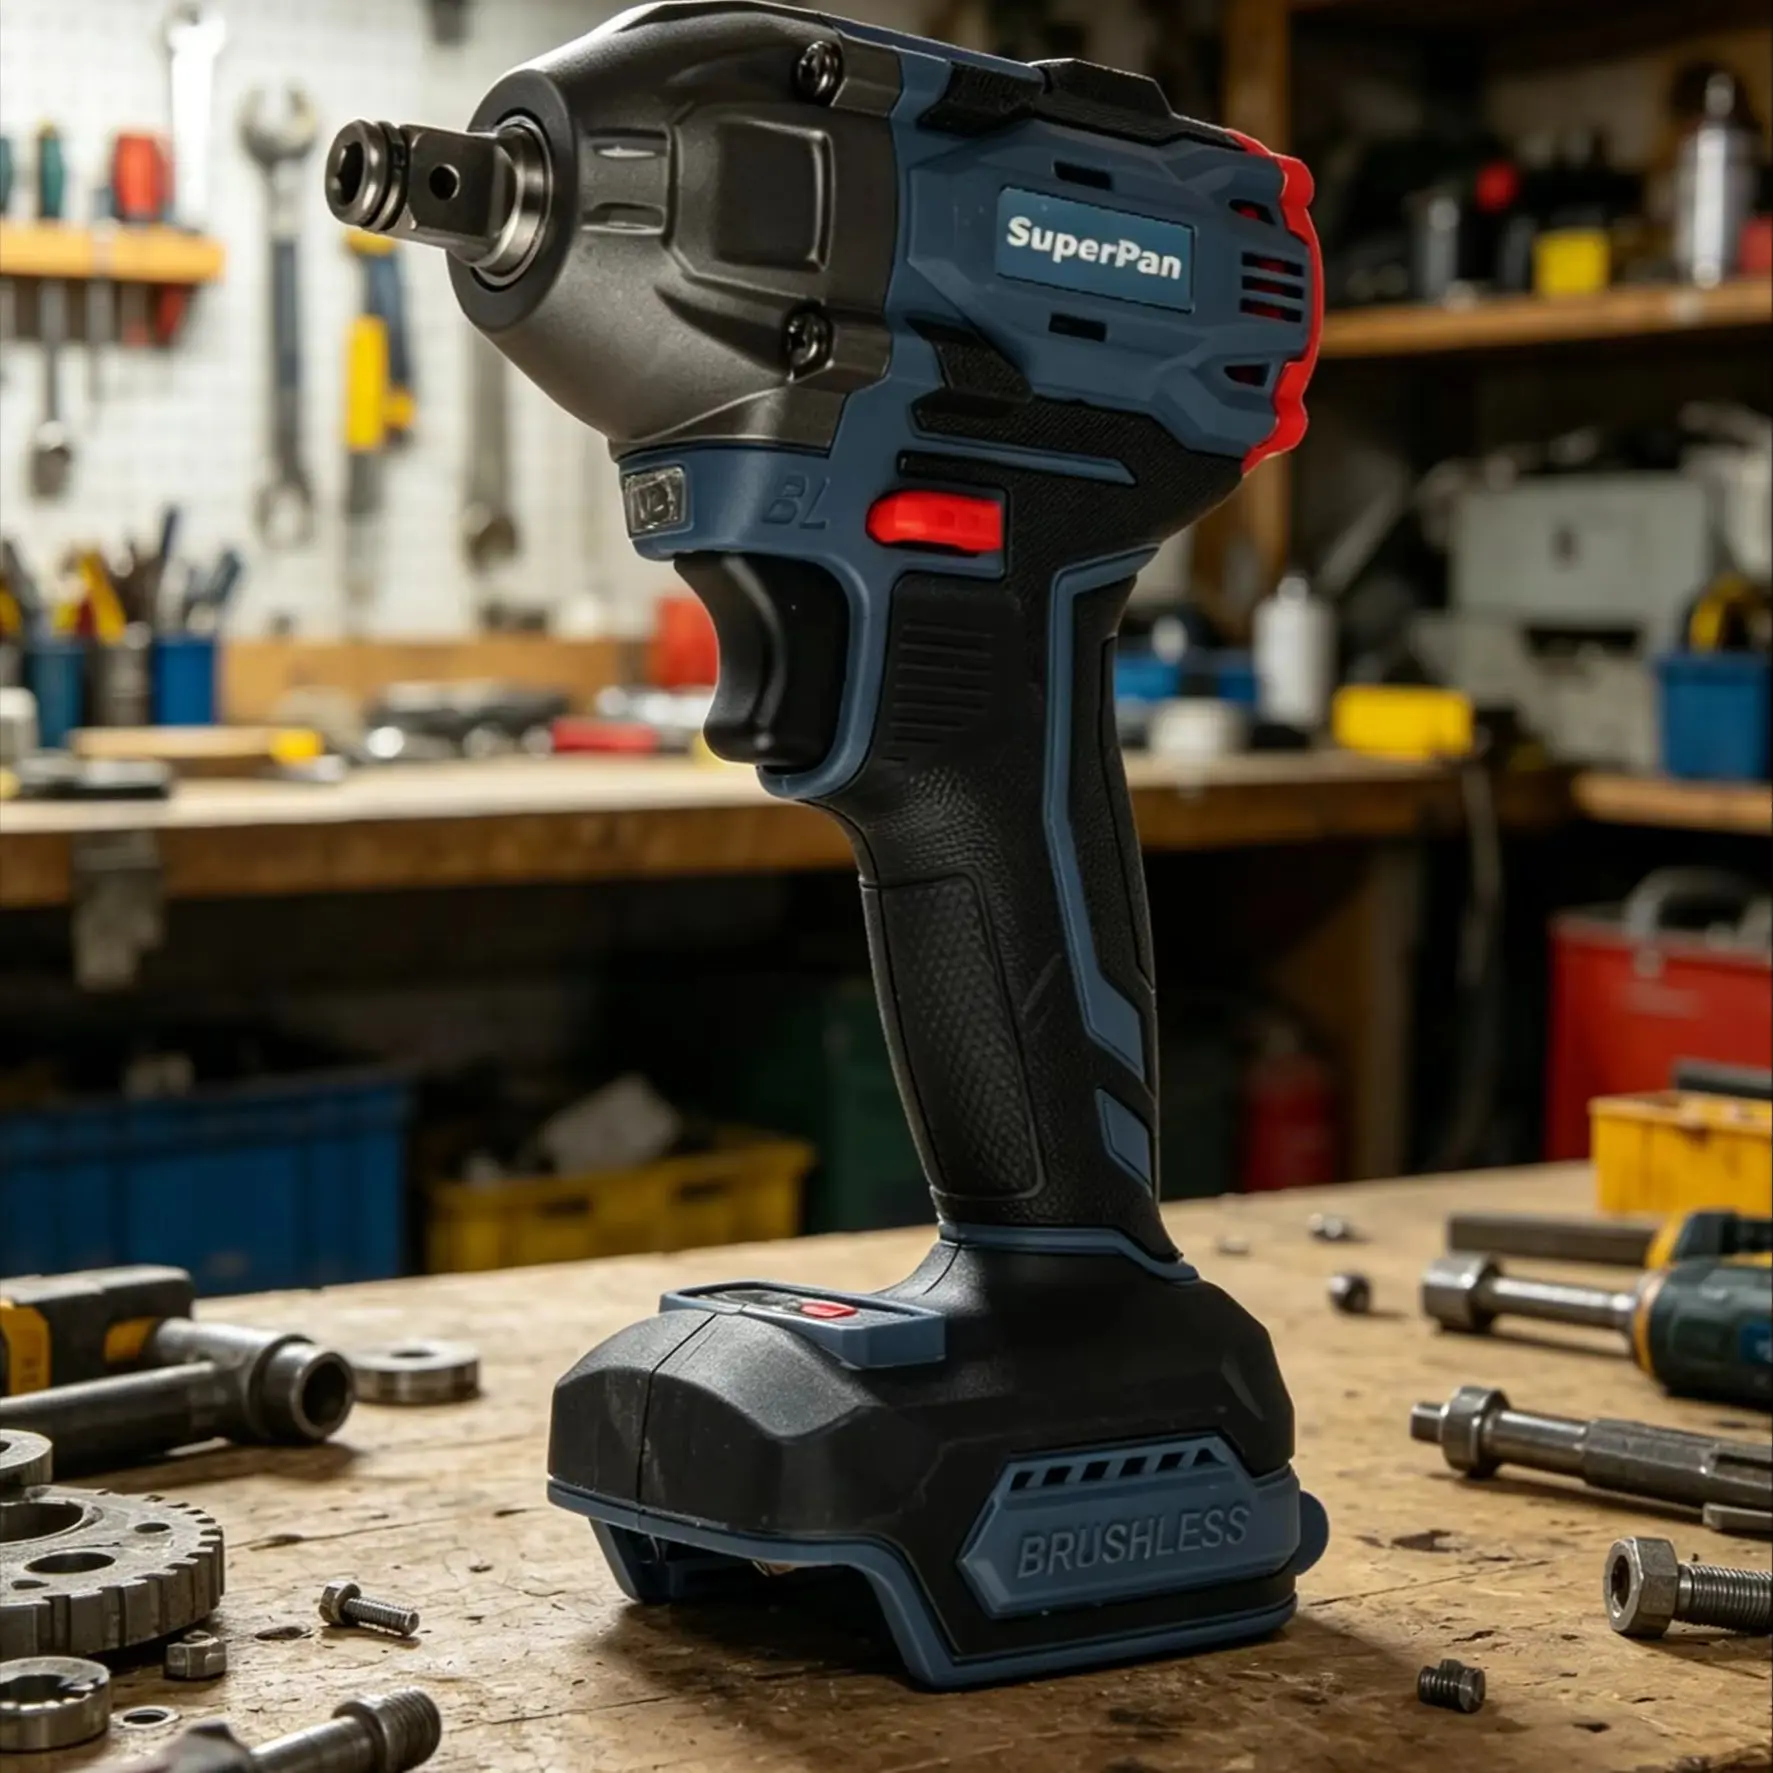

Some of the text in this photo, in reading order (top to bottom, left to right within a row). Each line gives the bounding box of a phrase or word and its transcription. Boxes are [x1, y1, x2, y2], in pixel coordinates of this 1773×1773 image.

[1006, 216, 1182, 279] SuperPan
[762, 475, 830, 529] BL
[1018, 1506, 1251, 1578] BRUSHLESS
